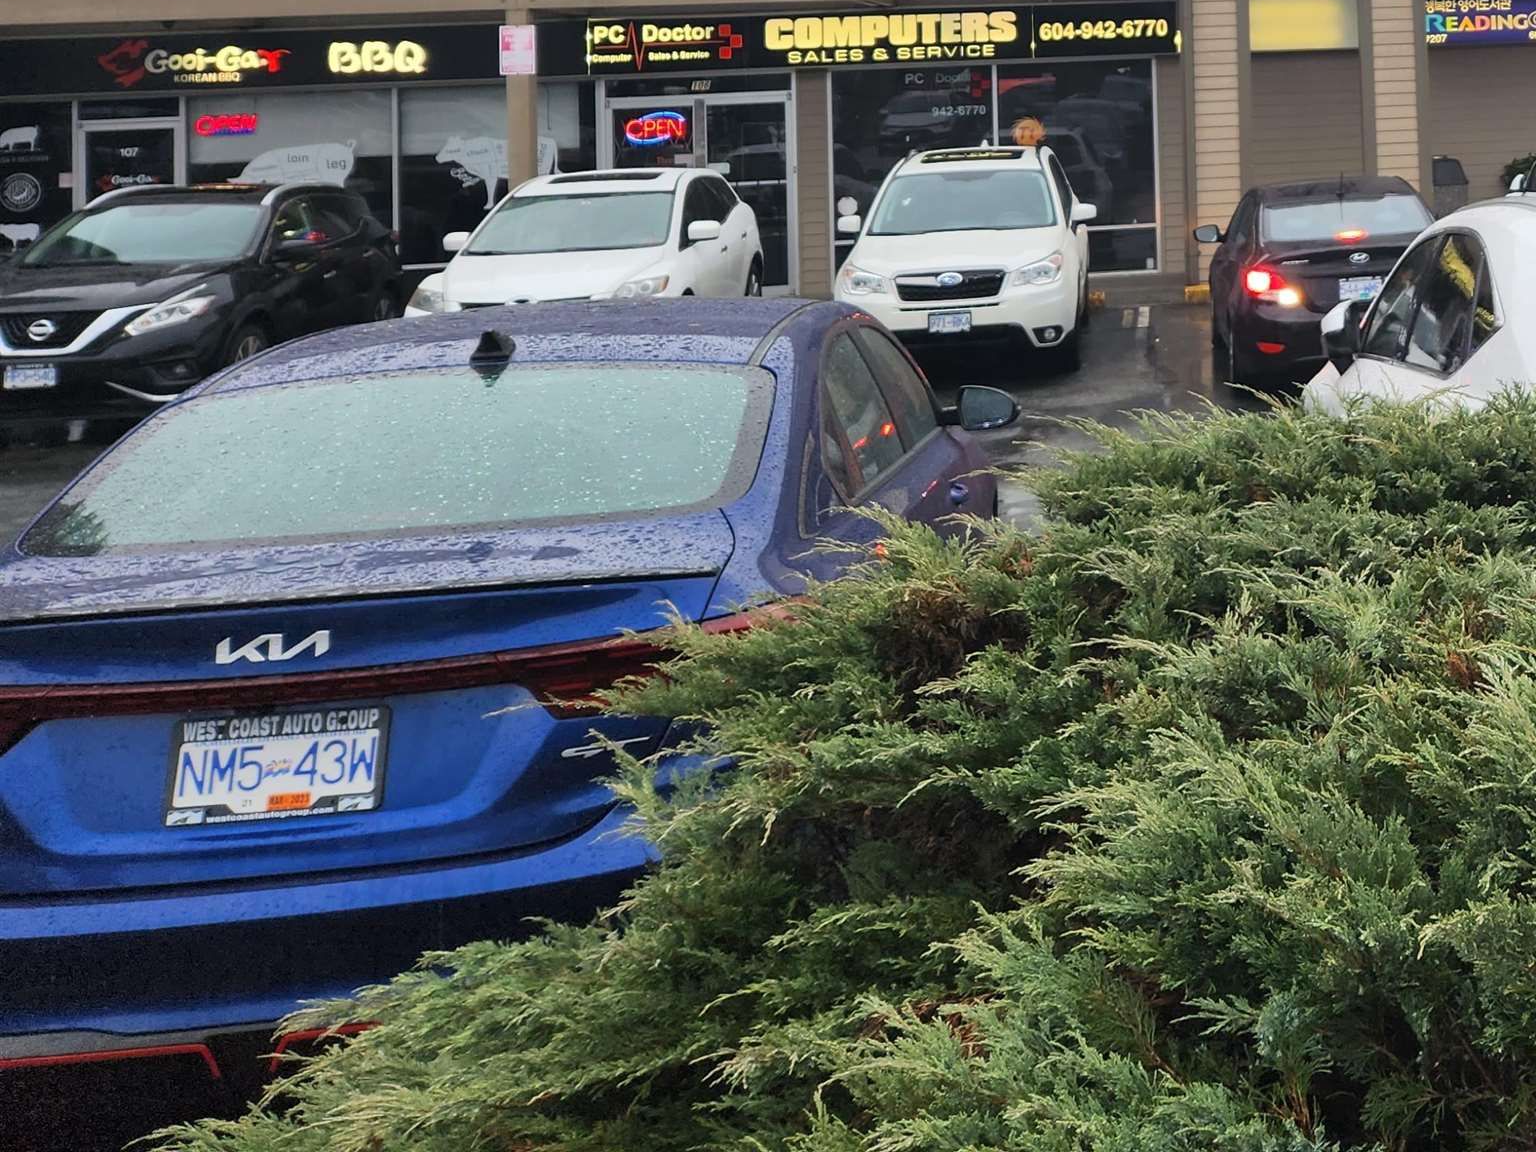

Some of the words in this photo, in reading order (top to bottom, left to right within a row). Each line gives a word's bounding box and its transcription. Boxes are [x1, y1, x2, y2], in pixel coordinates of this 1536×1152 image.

[593, 25, 625, 44] PC
[642, 23, 714, 43] Doctor
[765, 11, 1018, 51] COMPUTERS
[1039, 19, 1169, 41] 604-942-6770
[328, 40, 427, 73] BBQ
[592, 53, 632, 64] Computer
[648, 51, 671, 61] Sales
[679, 50, 710, 60] Service
[788, 48, 864, 64] SALES
[872, 48, 889, 61] &
[897, 44, 995, 61] SERVICE
[174, 71, 216, 83] KOREAN
[217, 71, 242, 83] BBQ
[905, 73, 924, 84] PC
[932, 104, 987, 117] 942-6770
[196, 113, 258, 136] OPEN
[626, 118, 684, 139] OPEN
[120, 147, 139, 158] 107
[215, 629, 331, 664] KIA
[229, 716, 279, 739] COAST
[282, 712, 322, 734] AUTO
[179, 745, 265, 798] NM5
[293, 735, 377, 786] 43W
